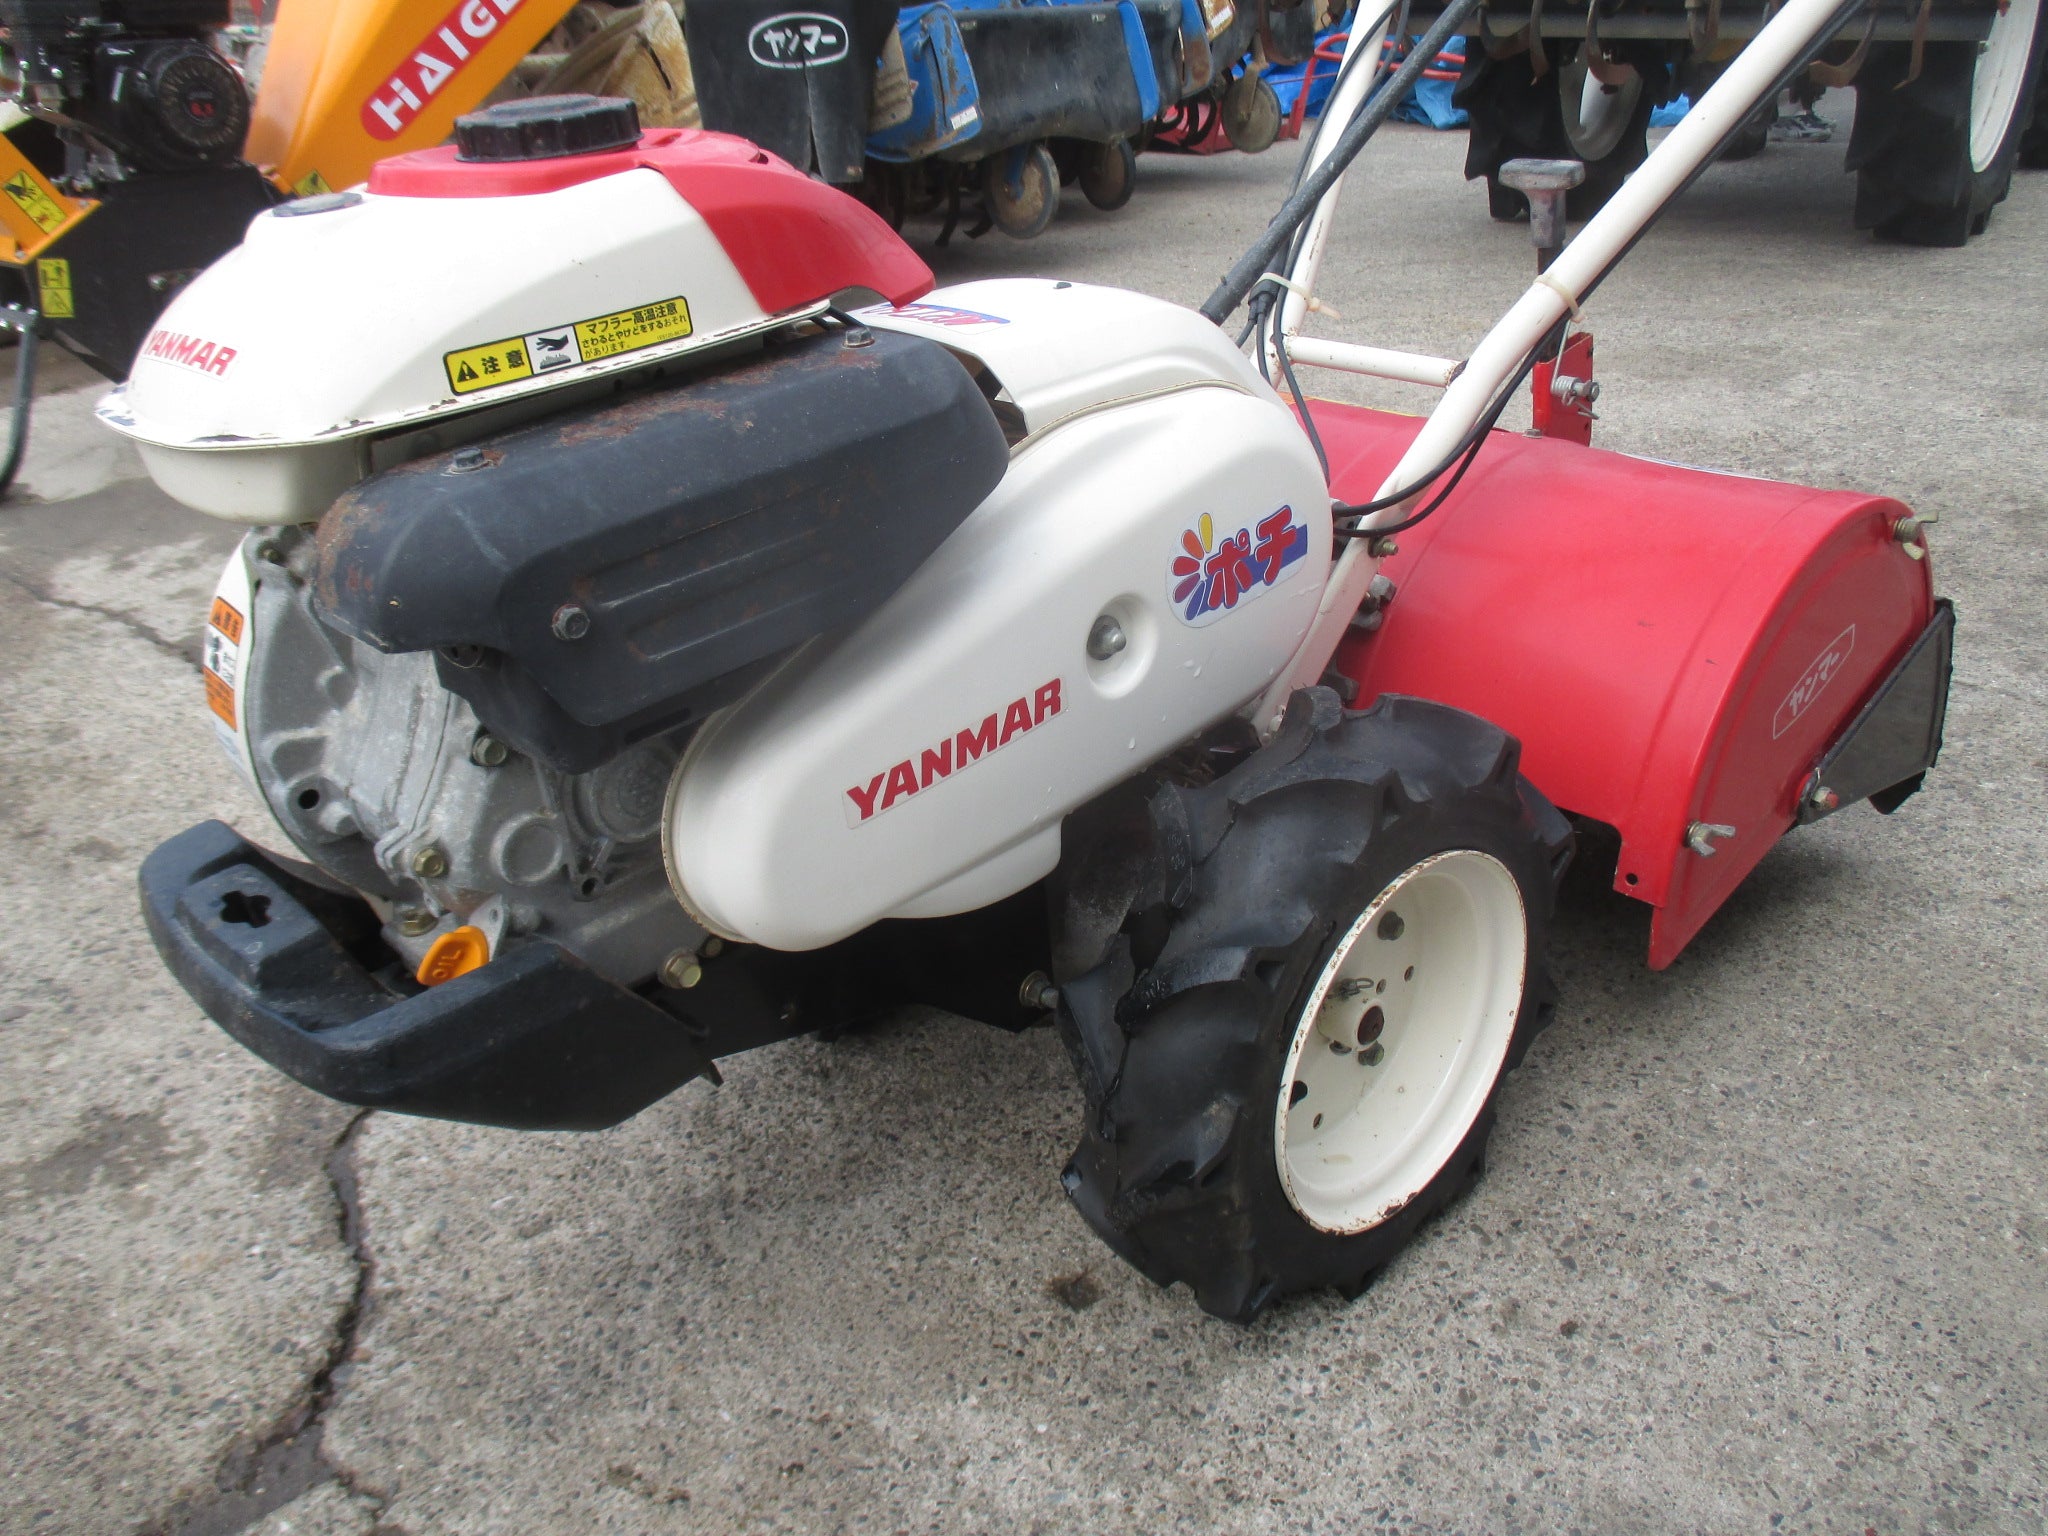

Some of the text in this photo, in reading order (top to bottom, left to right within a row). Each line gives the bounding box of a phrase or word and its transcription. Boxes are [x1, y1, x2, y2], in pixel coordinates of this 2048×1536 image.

[763, 26, 837, 58] ヤンマー
[582, 315, 687, 349] さわるとやけどをするおそれ
[586, 302, 678, 334] マフラー高温注意
[1204, 505, 1298, 610] ポチ
[1789, 652, 1840, 717] ヤンマー
[846, 677, 1061, 820] YANMAR
[432, 949, 462, 978] OIL
